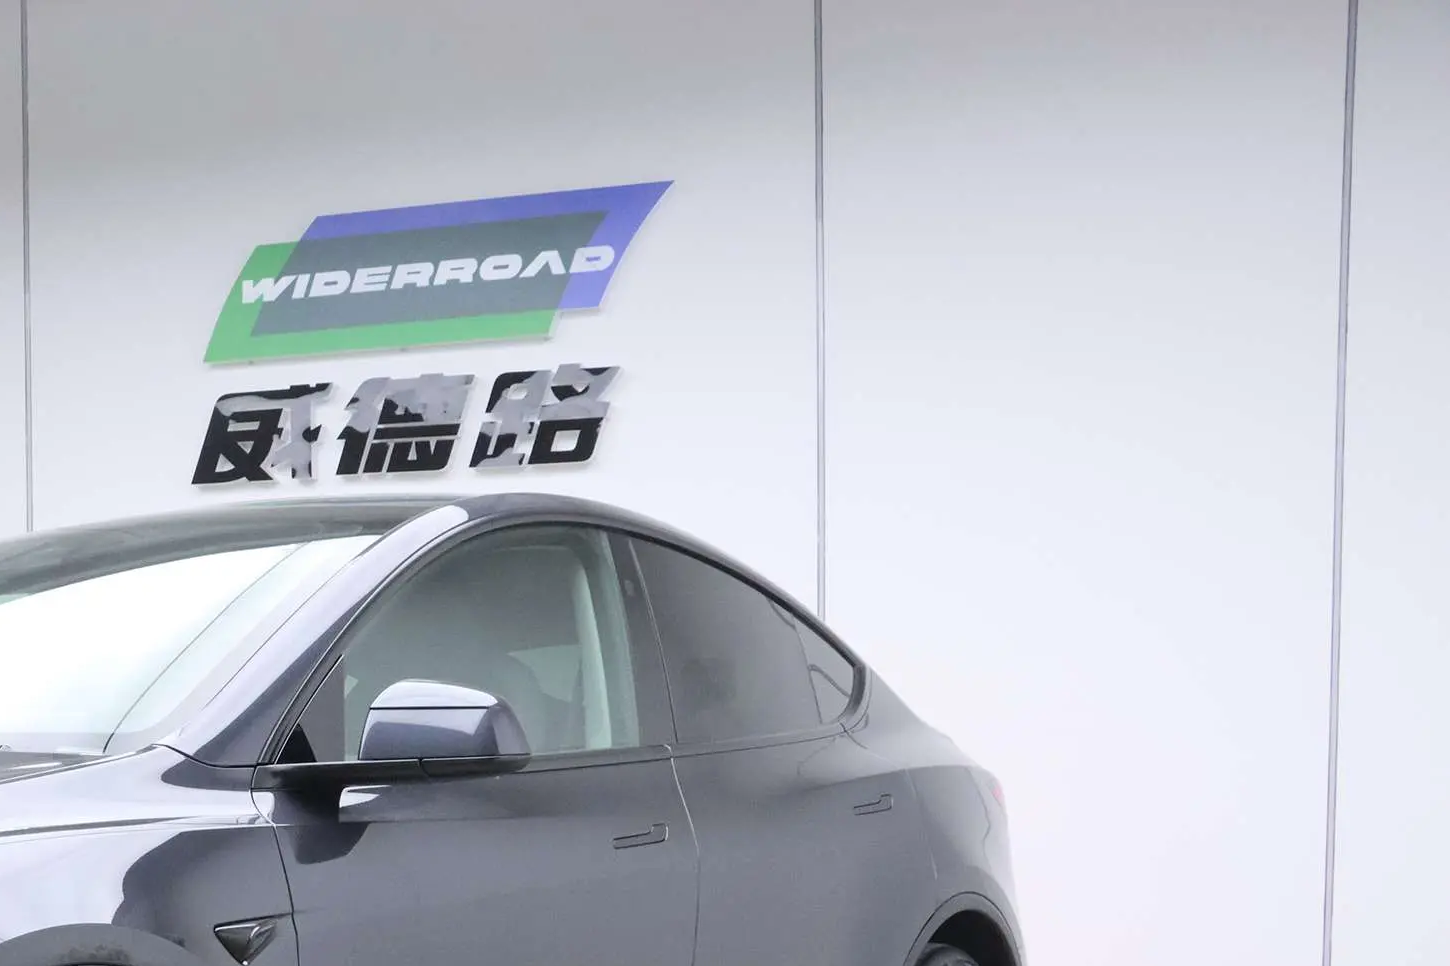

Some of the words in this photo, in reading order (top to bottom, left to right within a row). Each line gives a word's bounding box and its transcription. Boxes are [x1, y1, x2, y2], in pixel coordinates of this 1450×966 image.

[241, 245, 616, 304] WIDERROAD
[191, 363, 621, 486] 威德路
